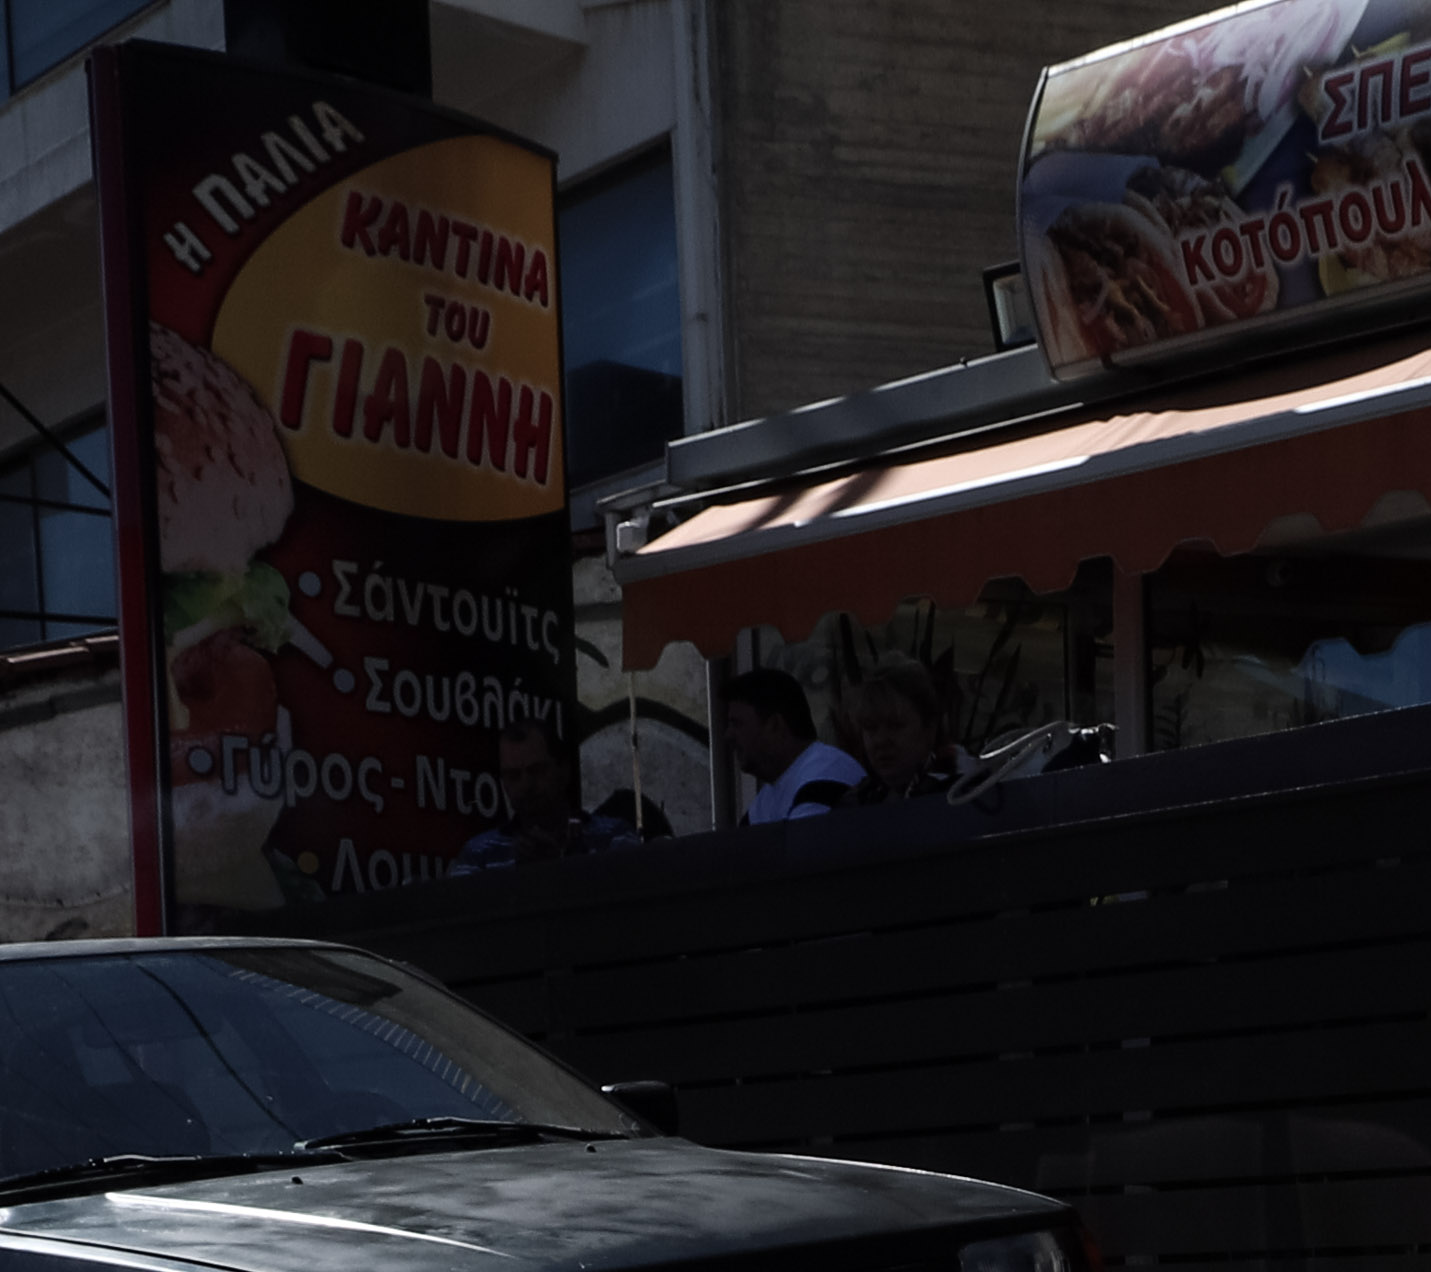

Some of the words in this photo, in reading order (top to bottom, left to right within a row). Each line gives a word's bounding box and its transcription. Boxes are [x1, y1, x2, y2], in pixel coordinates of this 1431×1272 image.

[162, 220, 213, 275] Η
[192, 100, 366, 236] ΠΑΛΙΑ
[340, 190, 550, 308] ΚΑΝΤΙΝΑ
[280, 329, 554, 486] ΓΙΑΝΝΗ
[331, 558, 561, 665] Σάντουϊτς
[220, 732, 385, 815] Γύρος
